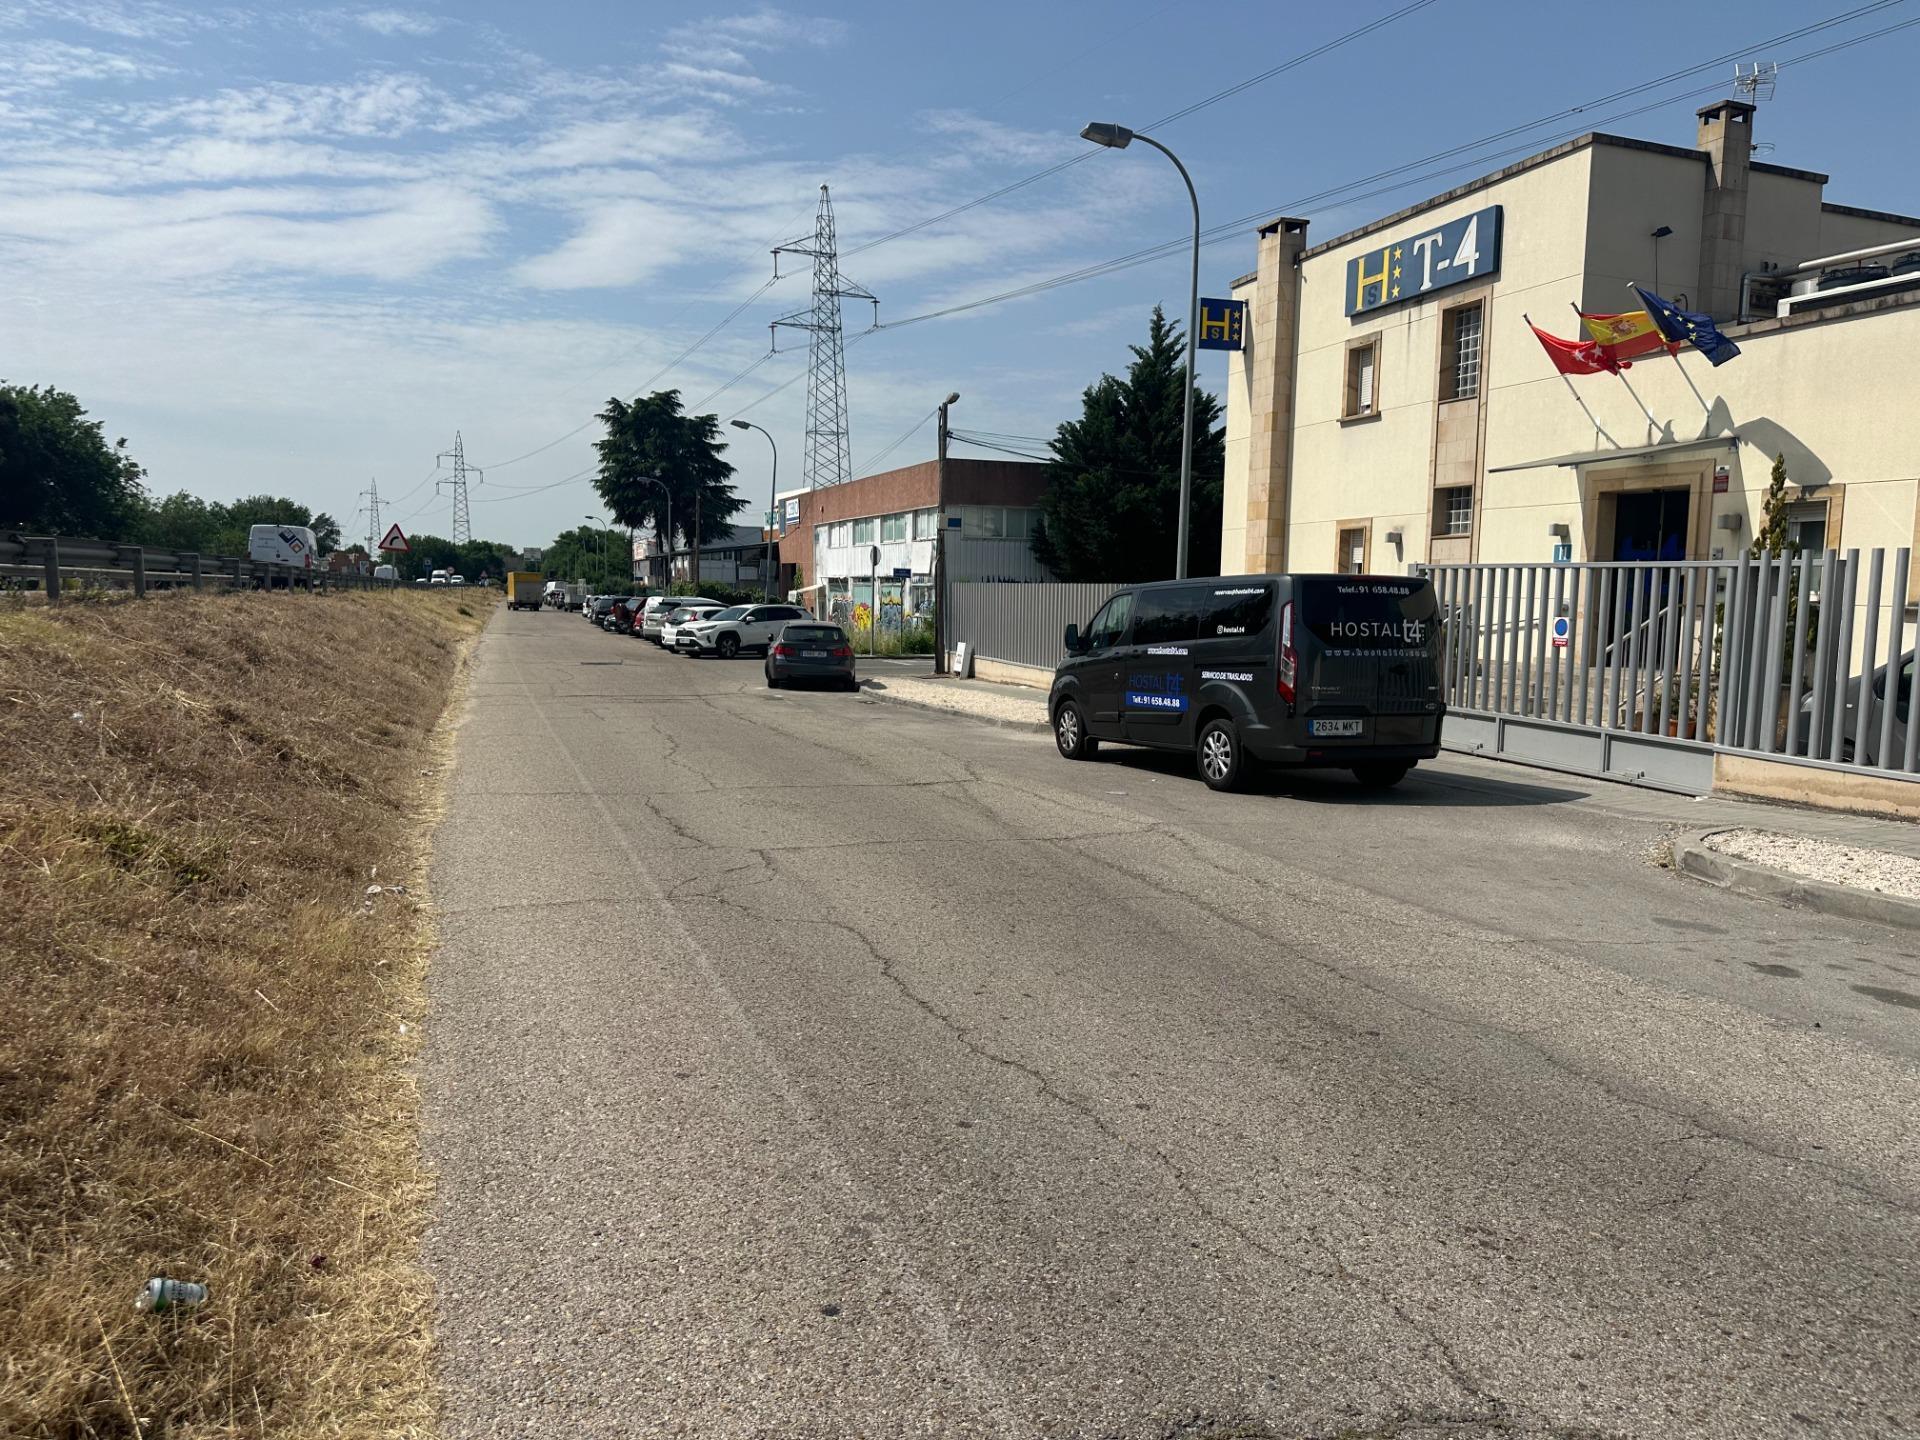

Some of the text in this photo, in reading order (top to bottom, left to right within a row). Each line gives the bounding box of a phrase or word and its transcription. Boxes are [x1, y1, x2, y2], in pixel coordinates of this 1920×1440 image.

[1413, 215, 1480, 291] T-4
[1330, 622, 1401, 637] HOSTAL
[1151, 697, 1180, 707] 658.48.88
[1315, 721, 1360, 731] 2634 MKT
